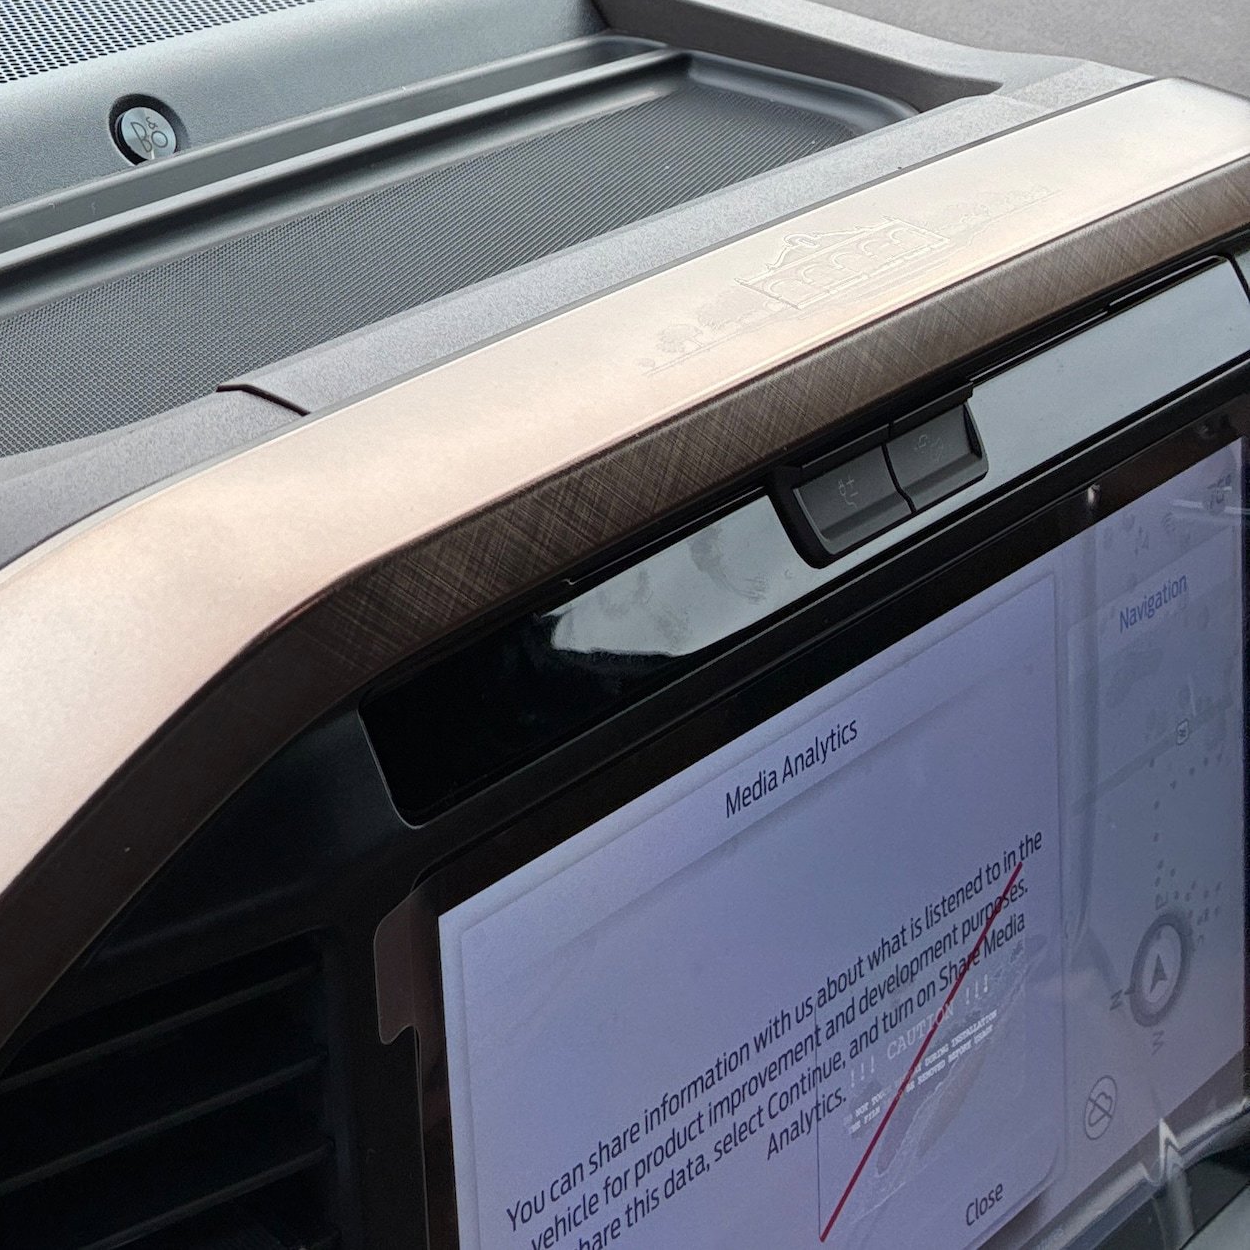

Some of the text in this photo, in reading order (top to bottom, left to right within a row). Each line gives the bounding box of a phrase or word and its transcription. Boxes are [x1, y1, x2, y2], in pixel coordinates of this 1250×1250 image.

[1119, 575, 1187, 634] Navigation
[726, 719, 858, 819] Media Analytics
[506, 831, 1042, 1232] You can share information with us about what is listened to in the
[531, 1193, 600, 1250] vehicle
[603, 1167, 631, 1205] for
[634, 1113, 705, 1188] product
[708, 1022, 822, 1128] improvement
[825, 996, 856, 1039] and
[858, 926, 959, 1021] development
[961, 878, 1029, 946] purposes.
[575, 1217, 622, 1250] hare
[624, 1187, 660, 1228] this
[664, 1152, 710, 1199] data,
[713, 1107, 764, 1163] select
[768, 1051, 847, 1120] Continue,
[850, 1024, 879, 1060] and
[882, 998, 914, 1034] turn
[917, 980, 936, 1008] on
[939, 949, 980, 993] Share
[984, 911, 1025, 958] Media
[767, 1087, 847, 1161] Analytics.
[965, 1183, 1005, 1227] Close
